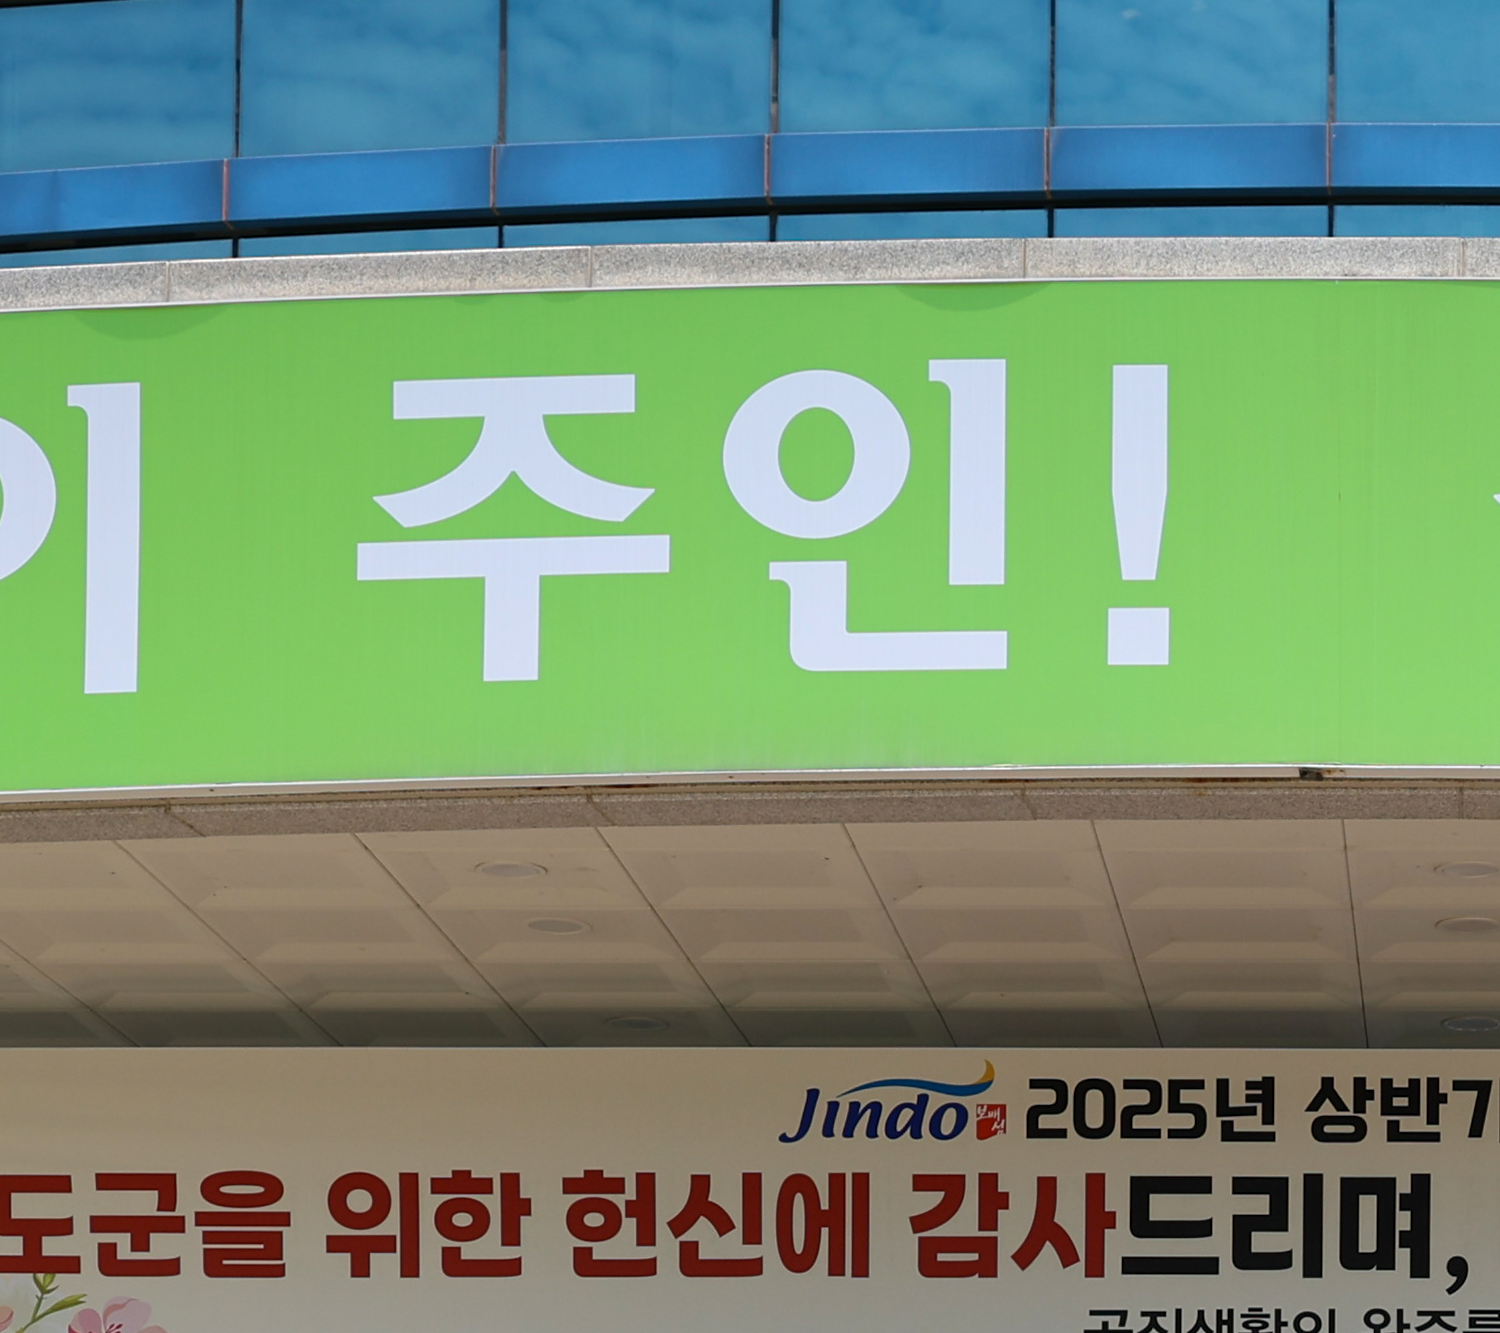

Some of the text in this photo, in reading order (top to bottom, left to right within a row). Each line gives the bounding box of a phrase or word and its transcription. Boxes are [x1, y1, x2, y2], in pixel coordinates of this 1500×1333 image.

[356, 358, 1171, 682] 주인!
[779, 1088, 968, 1143] Jindo
[1025, 1076, 1276, 1142] 2025년
[326, 1170, 531, 1277] 위한
[562, 1170, 869, 1277] 헌신에
[909, 1172, 1468, 1294] 감사드리며,
